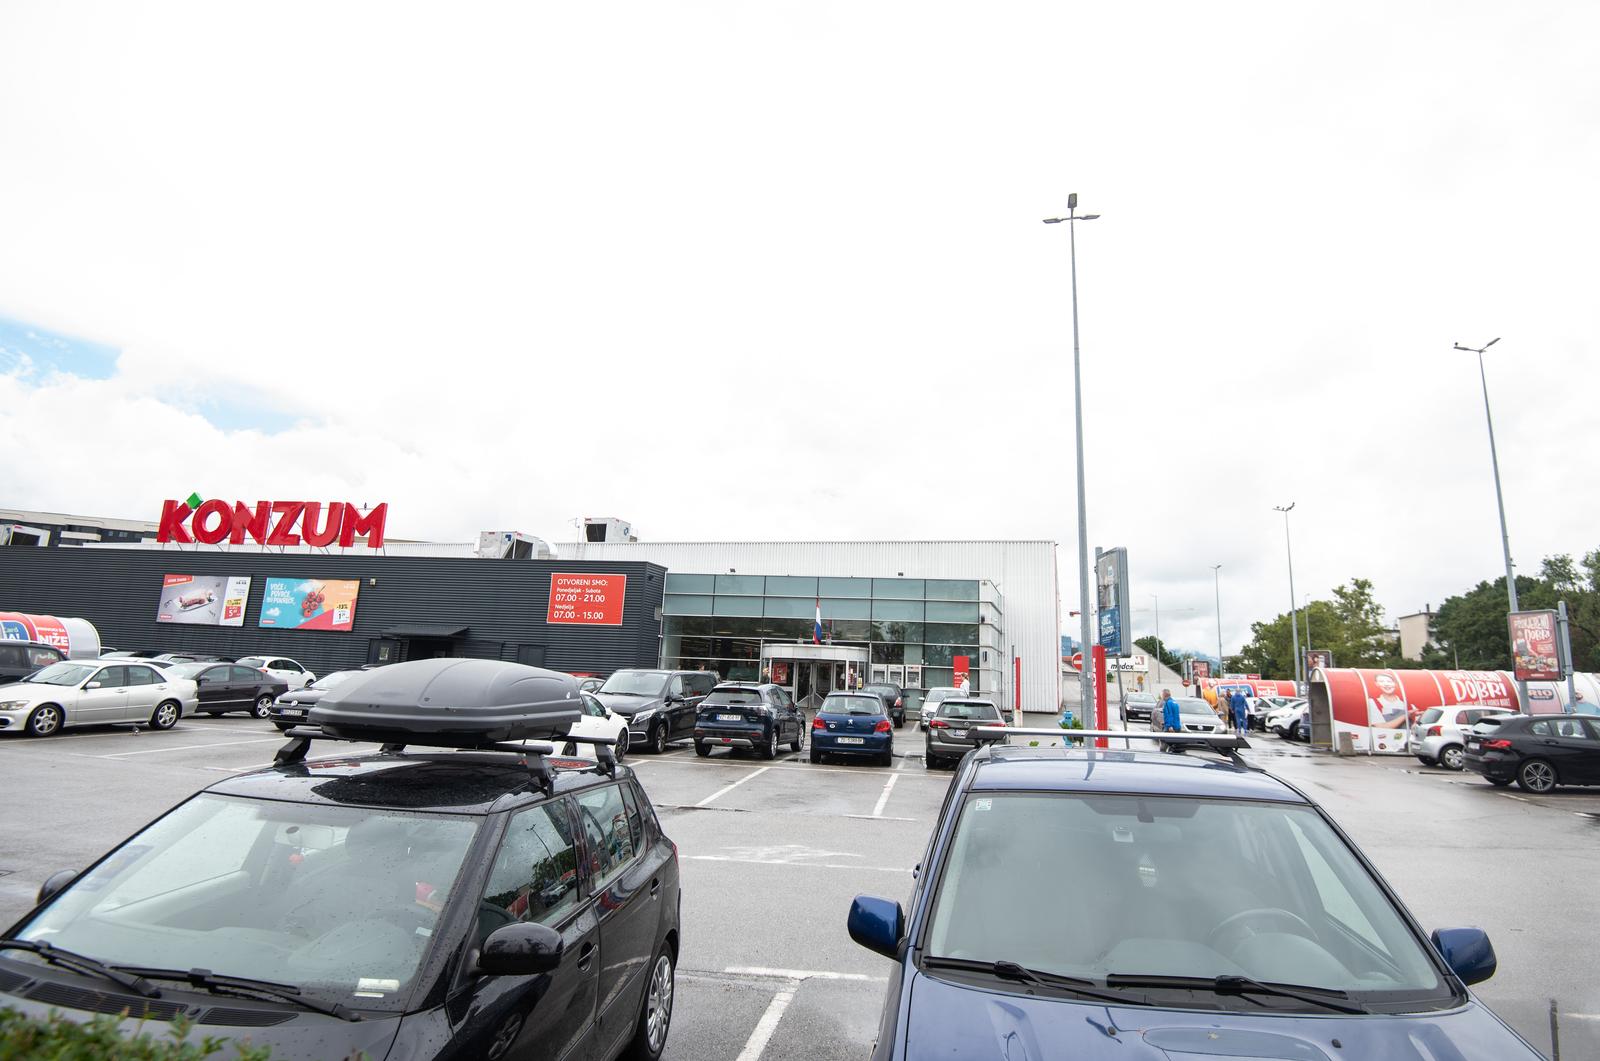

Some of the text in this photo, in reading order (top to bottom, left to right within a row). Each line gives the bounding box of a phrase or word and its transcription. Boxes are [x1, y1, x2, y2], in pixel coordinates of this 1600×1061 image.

[157, 498, 388, 548] KONZUM
[556, 594, 577, 602] 07.00
[584, 594, 605, 602] 21.00
[554, 603, 574, 611] Nedjelja
[554, 611, 575, 619] 07.00
[583, 611, 604, 620] 15.00
[1449, 679, 1508, 702] DOBRI
